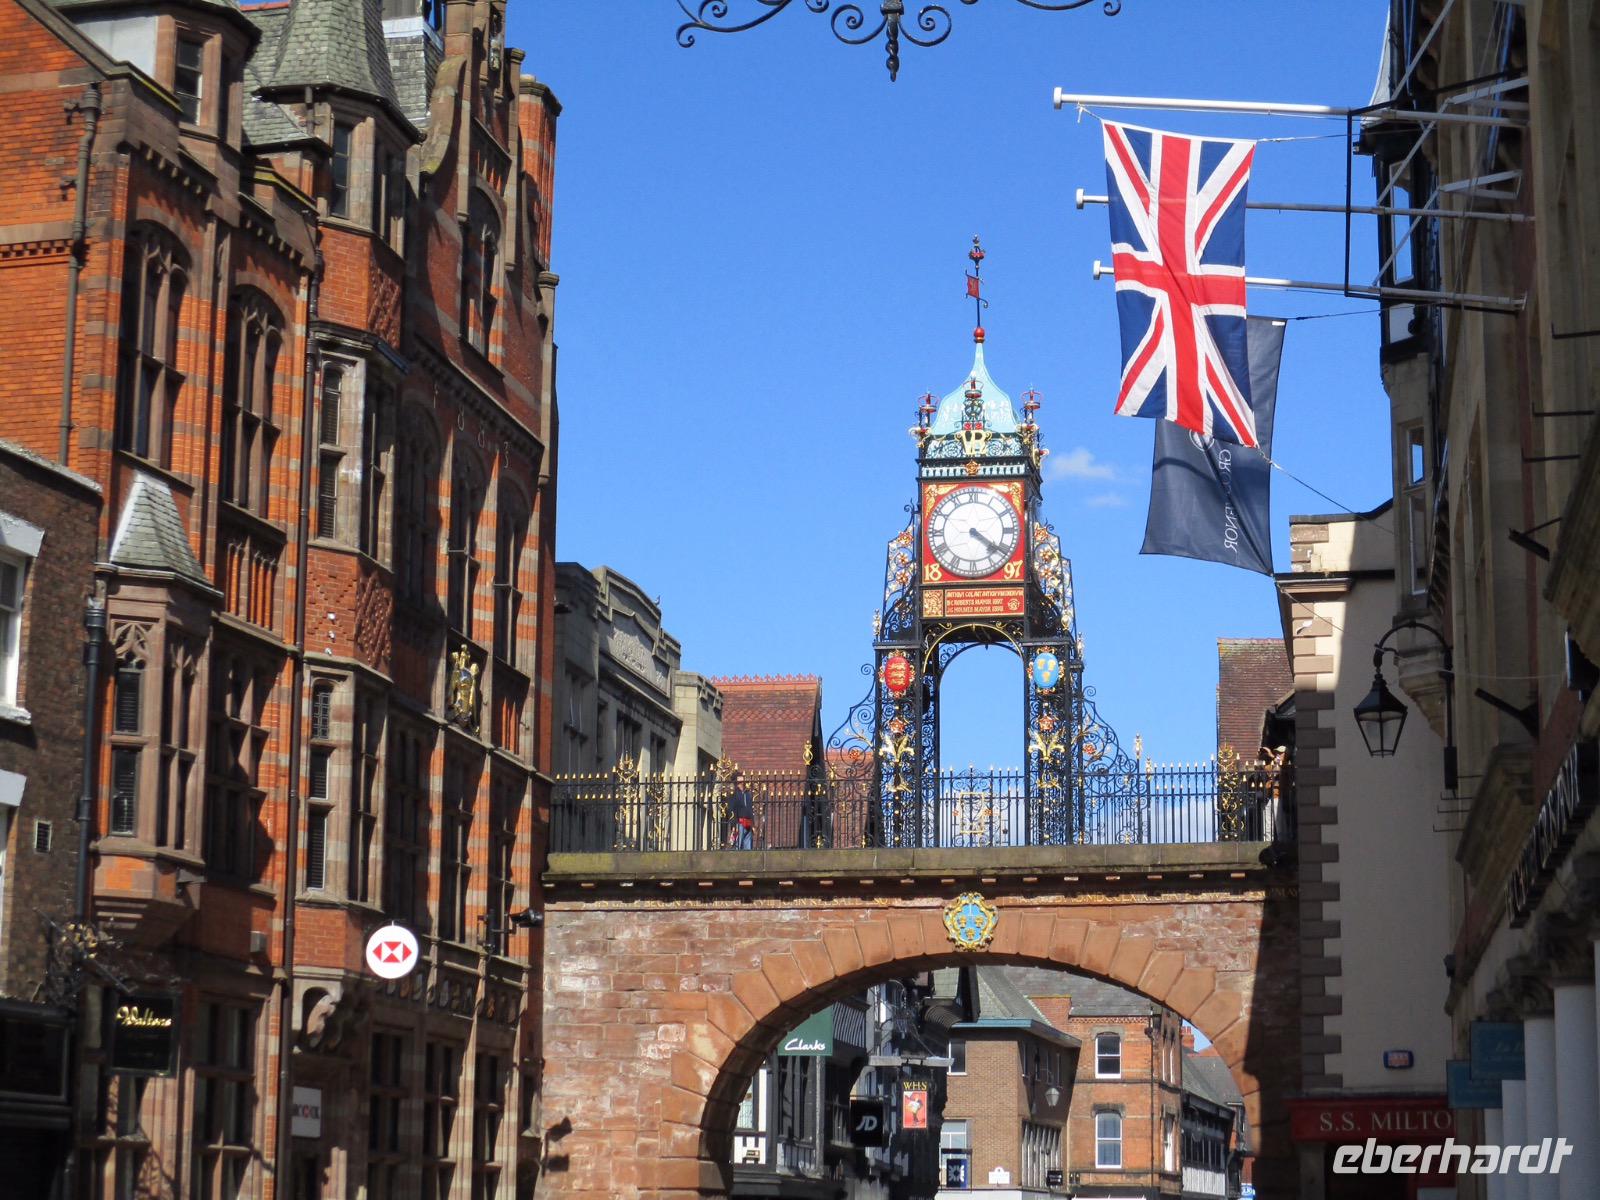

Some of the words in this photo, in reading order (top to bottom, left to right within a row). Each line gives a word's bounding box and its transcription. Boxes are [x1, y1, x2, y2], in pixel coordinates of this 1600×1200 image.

[924, 563, 943, 581] 18
[1003, 560, 1023, 579] 97
[785, 1038, 826, 1051] Clarks
[903, 1081, 928, 1091] WHS
[856, 1115, 878, 1131] JD
[1319, 1112, 1361, 1132] S.S.
